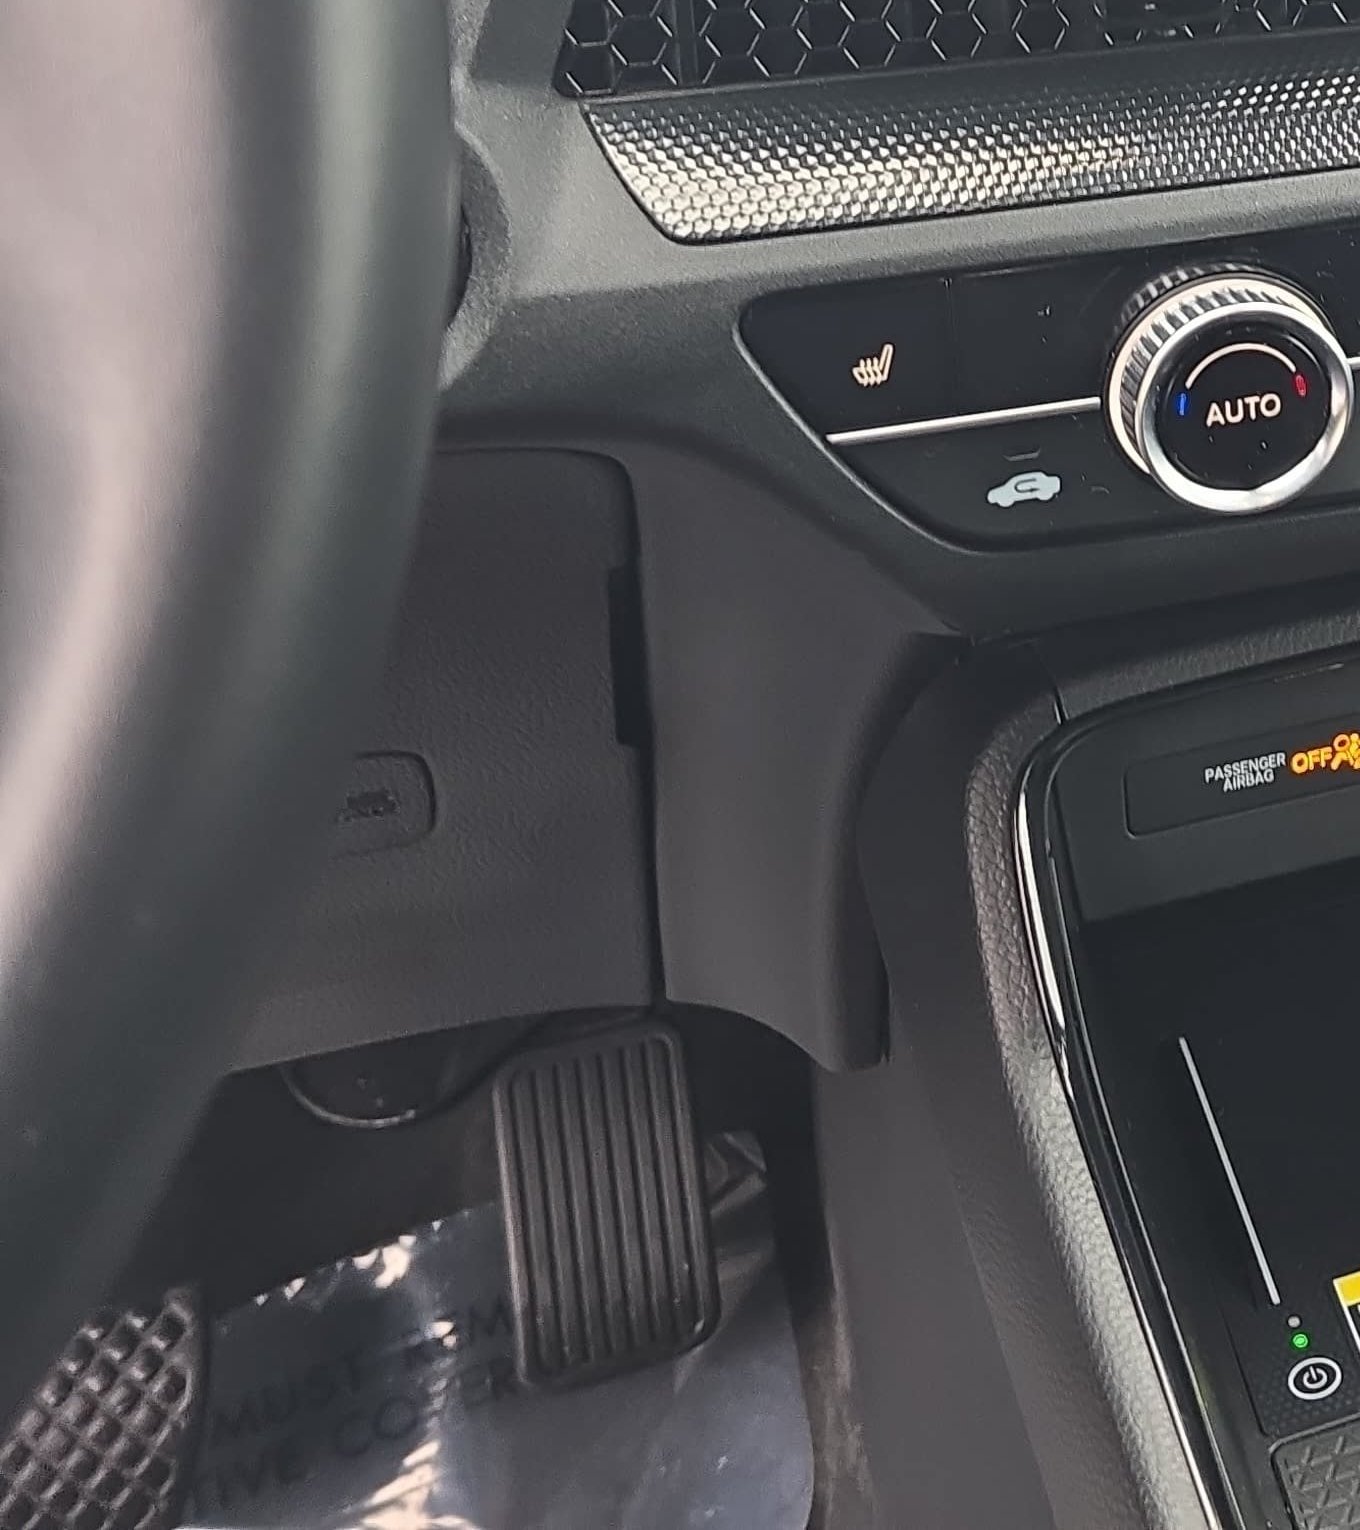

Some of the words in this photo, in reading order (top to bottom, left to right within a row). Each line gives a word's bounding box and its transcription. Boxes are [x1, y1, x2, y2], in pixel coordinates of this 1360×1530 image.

[1205, 392, 1283, 429] AUTO
[1205, 752, 1286, 783] PASSENGER
[1291, 746, 1333, 774] OFF
[1223, 769, 1274, 792] AIRBAG
